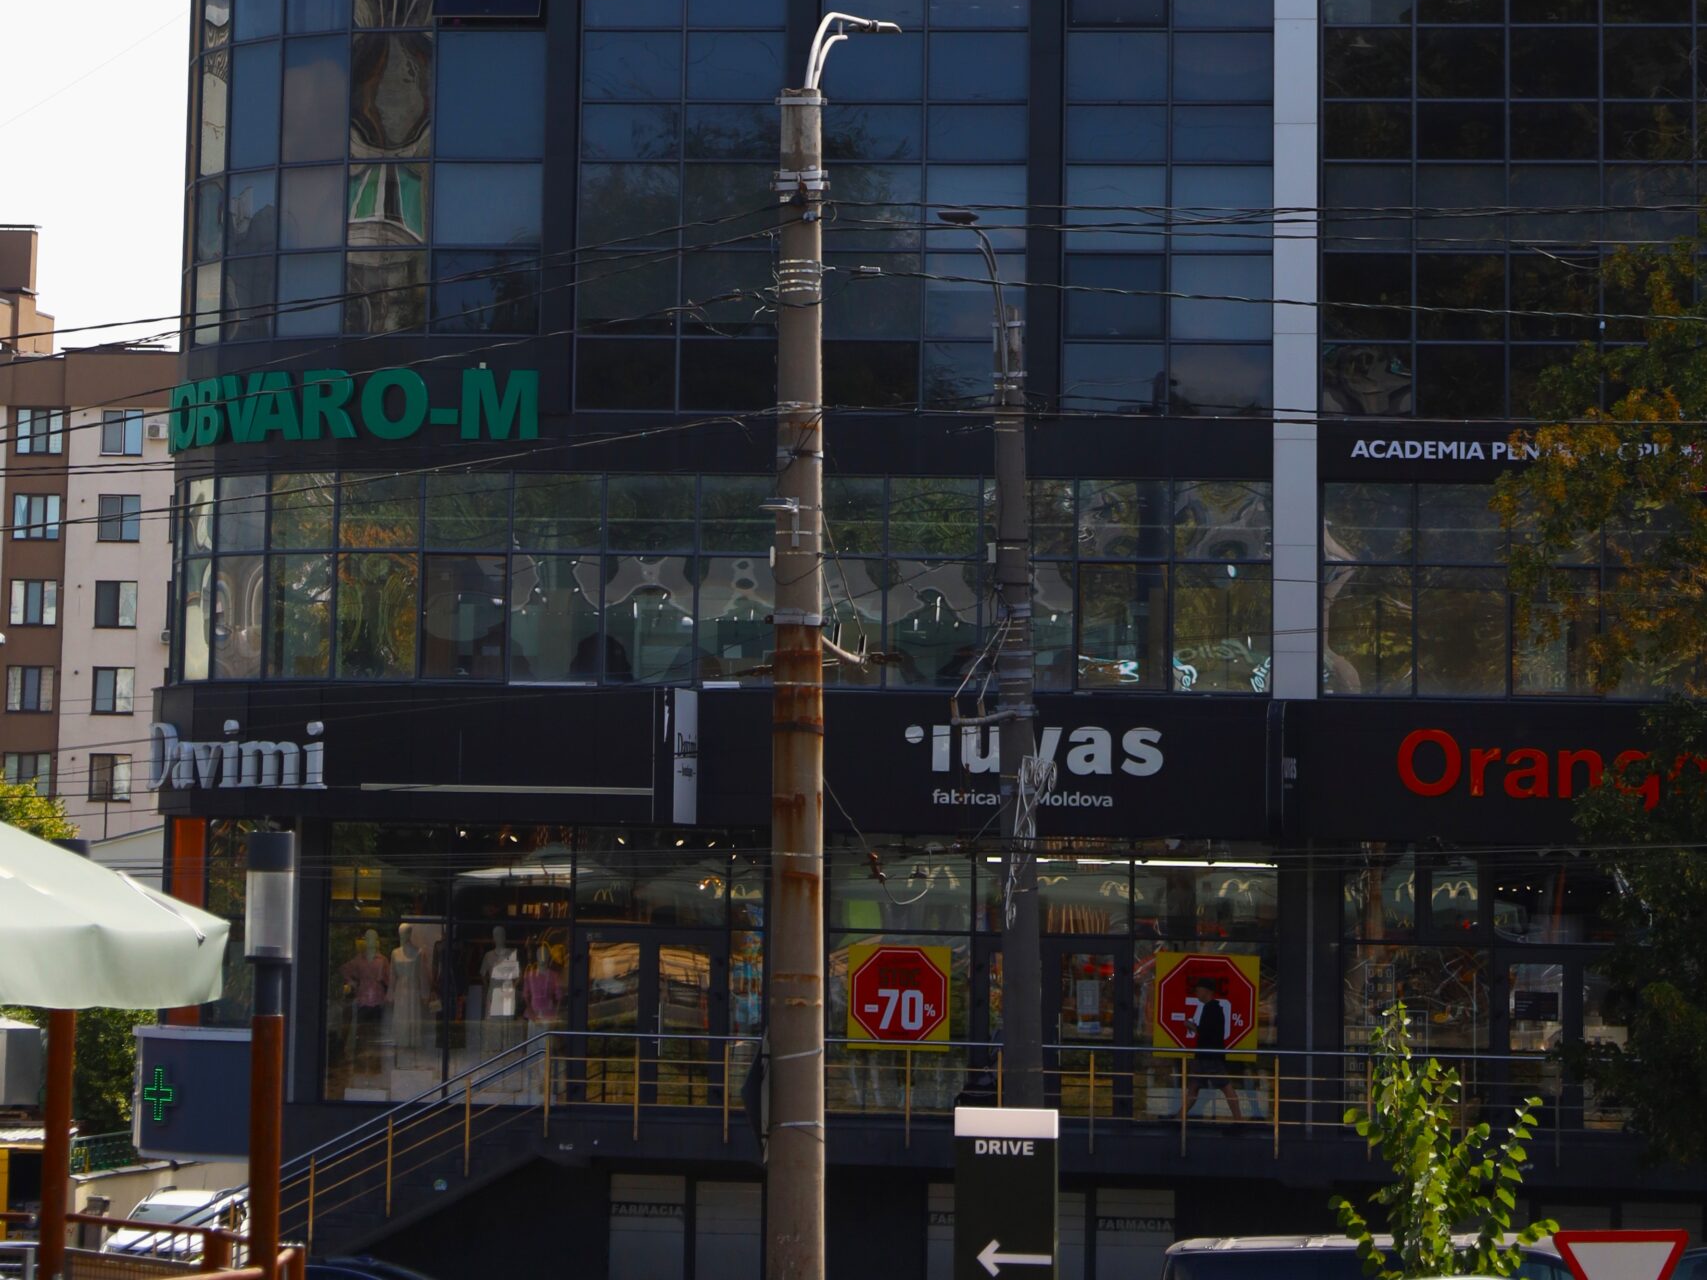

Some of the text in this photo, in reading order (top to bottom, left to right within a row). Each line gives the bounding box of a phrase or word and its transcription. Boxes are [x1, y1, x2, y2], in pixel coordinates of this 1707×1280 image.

[168, 366, 539, 455] OBVARO-M
[1350, 439, 1486, 461] ACADEMIA
[146, 719, 328, 790] Davimi
[932, 788, 1114, 808] fabrica Moldova
[863, 988, 936, 1031] -70%
[974, 1140, 1035, 1156] DRIVE
[611, 1203, 684, 1217] FARMACIA
[1098, 1218, 1173, 1232] FARMACIA
